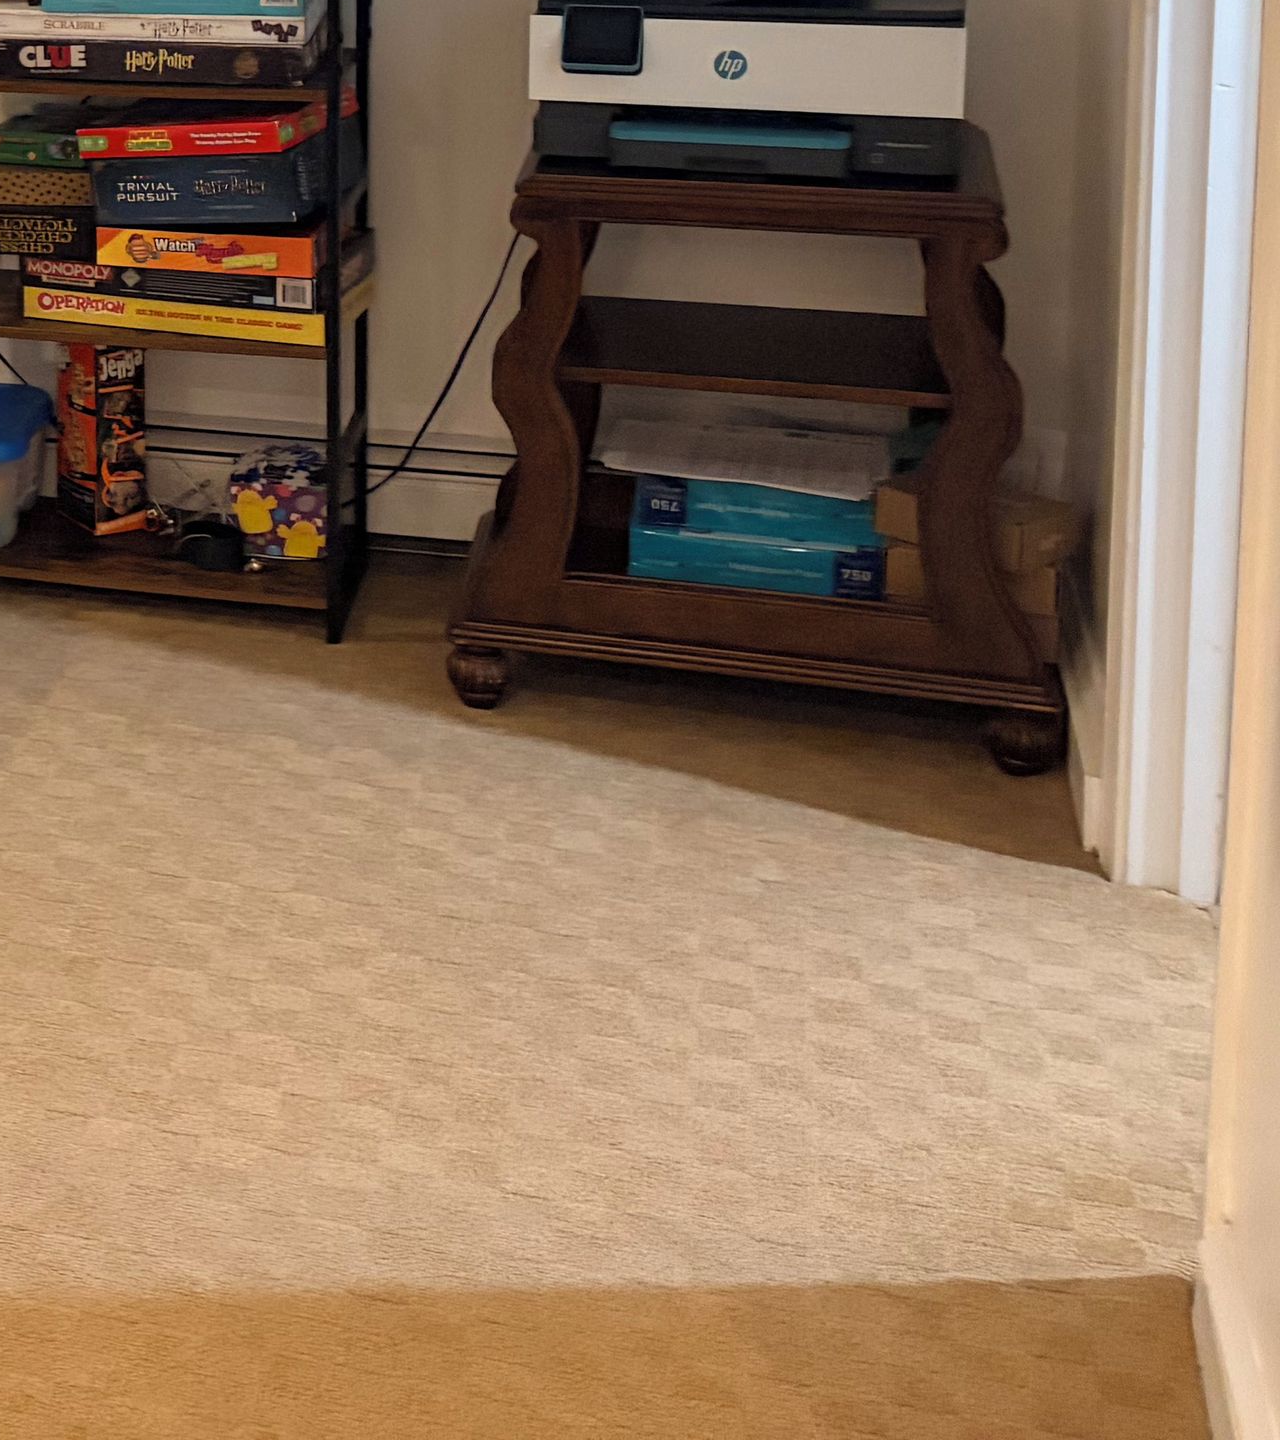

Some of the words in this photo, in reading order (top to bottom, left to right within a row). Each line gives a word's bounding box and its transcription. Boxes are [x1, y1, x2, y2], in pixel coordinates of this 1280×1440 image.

[43, 19, 105, 32] SCRABBLE
[18, 45, 87, 70] CLUE
[124, 50, 159, 73] Harry
[158, 48, 195, 75] Potter
[716, 50, 744, 79] hp
[116, 191, 180, 203] PURSUIT
[117, 181, 175, 192] TRIVIAL
[0, 241, 54, 253] CHESS
[153, 237, 196, 253] Watch
[27, 260, 112, 281] MONOPOLY
[37, 292, 126, 315] OPERATION
[98, 348, 144, 382] Jenga
